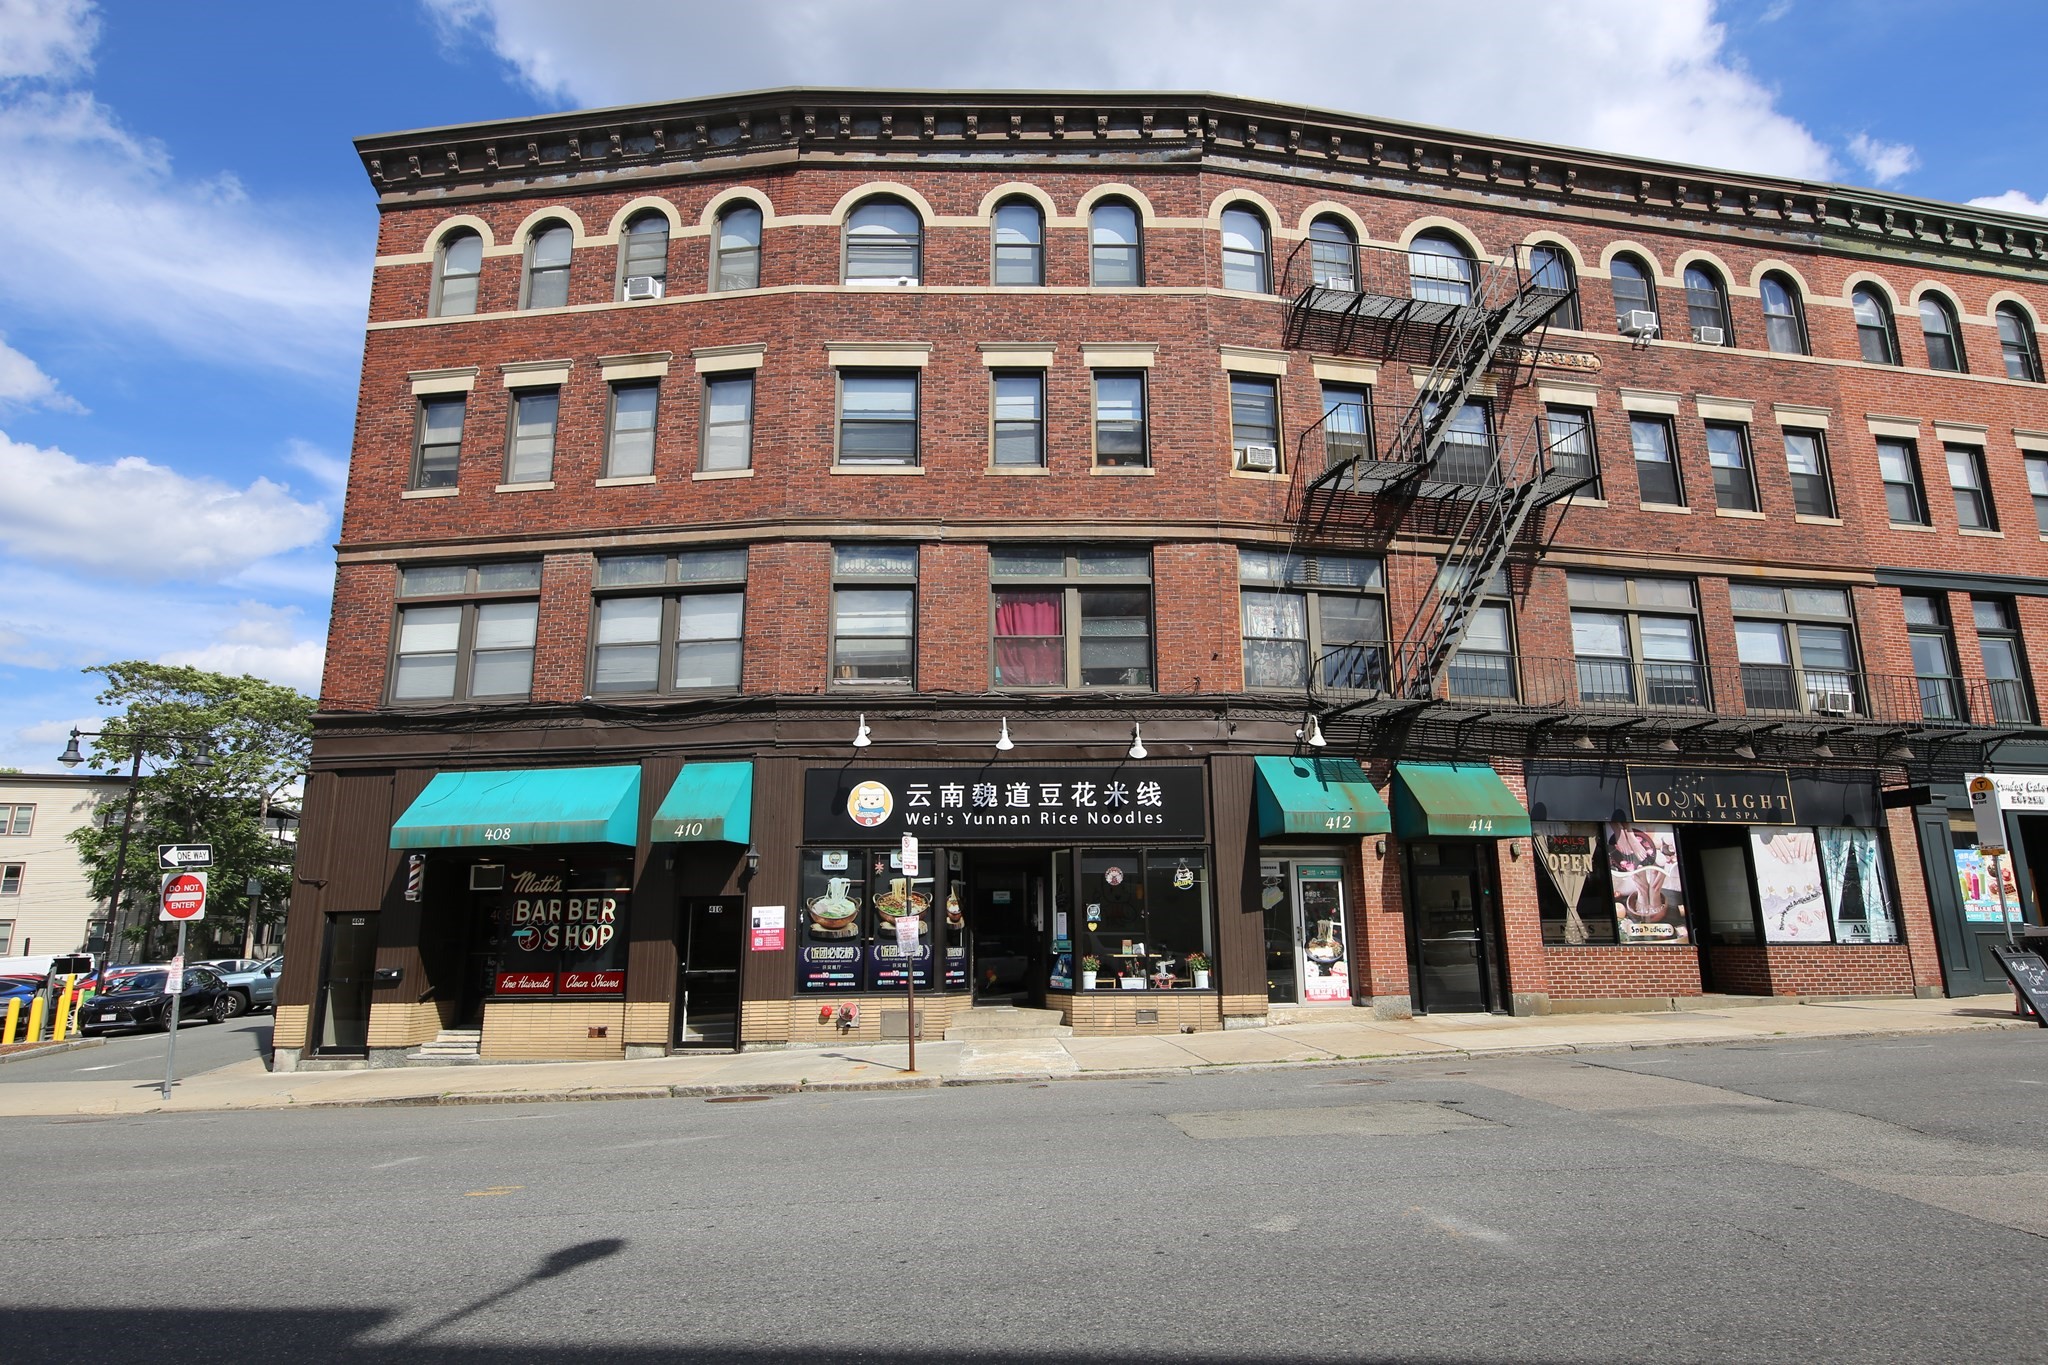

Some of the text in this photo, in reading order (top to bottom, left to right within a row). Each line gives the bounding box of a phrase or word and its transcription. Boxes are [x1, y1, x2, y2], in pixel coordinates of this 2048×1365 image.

[906, 781, 1163, 809] 云南魏道豆花米线
[905, 811, 1163, 826] Wei's Yunnan Rice Noodles
[1671, 810, 1759, 819] NAILS & SPA
[1325, 815, 1351, 830] 412
[1469, 818, 1493, 832] 414
[485, 827, 511, 841] 408
[674, 823, 703, 838] 410
[1553, 836, 1585, 845] NAILS
[176, 850, 207, 861] ONE WAY
[1548, 854, 1593, 872] OPEN
[169, 884, 200, 893] DO NOT
[511, 871, 562, 893] Matt's
[171, 901, 196, 910] ENTER
[512, 899, 617, 925] BARBER
[542, 924, 614, 951] SHOP
[501, 976, 516, 989] Fine
[518, 975, 551, 989] Haircuts
[565, 974, 619, 989] Clean Shaves
